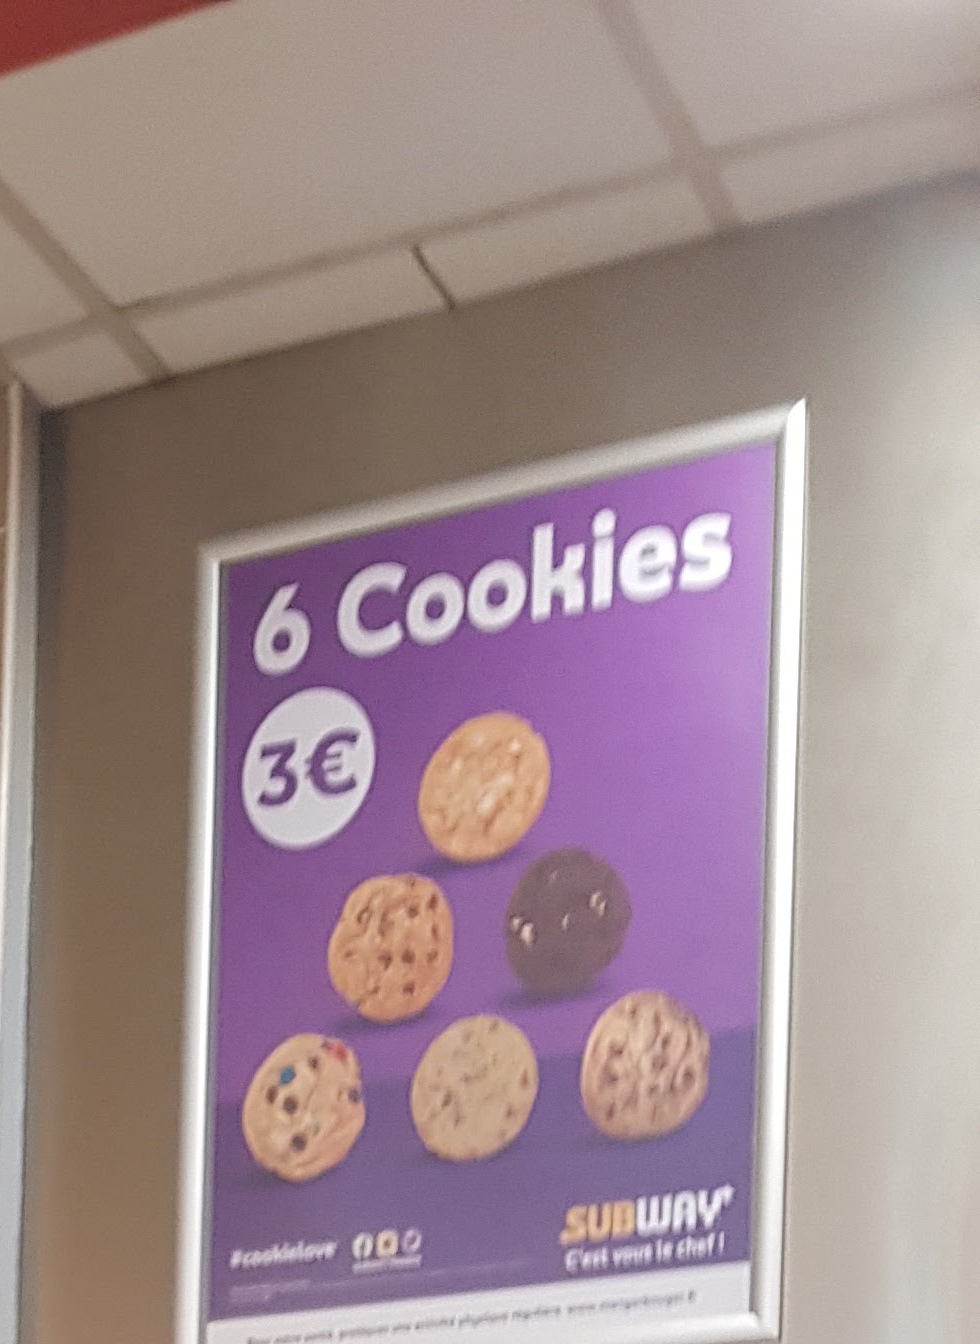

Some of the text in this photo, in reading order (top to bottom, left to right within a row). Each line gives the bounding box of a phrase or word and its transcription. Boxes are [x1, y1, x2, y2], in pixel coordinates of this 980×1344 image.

[252, 507, 734, 678] 6 Cookies
[256, 726, 361, 808] 3€
[560, 1183, 735, 1248] SUBWAY
